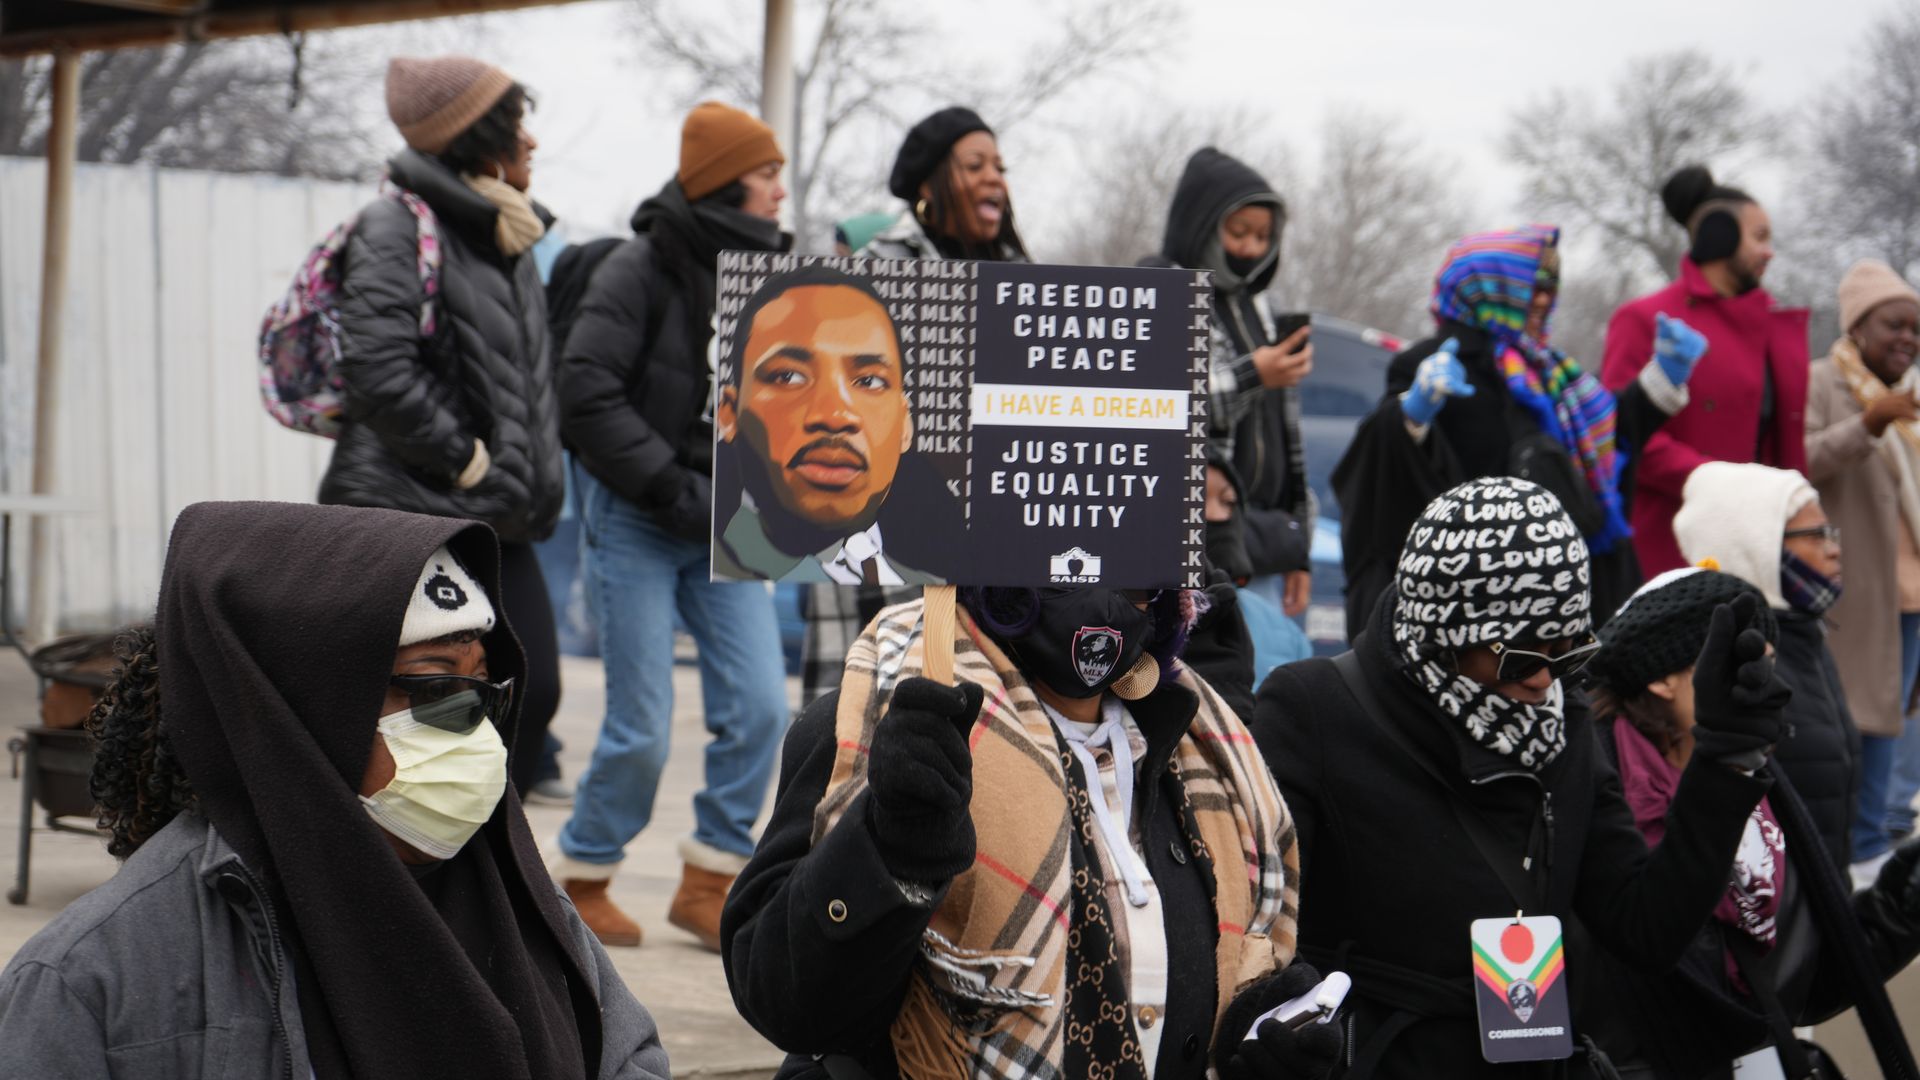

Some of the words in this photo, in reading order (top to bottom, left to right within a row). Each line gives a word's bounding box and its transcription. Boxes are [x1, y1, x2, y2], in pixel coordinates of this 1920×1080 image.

[722, 253, 768, 272] MLK
[872, 260, 917, 277] MLK
[921, 261, 967, 279] MLK
[921, 281, 967, 300] MLK
[996, 282, 1157, 309] FREEDOM
[889, 303, 916, 321] LK
[920, 304, 966, 322] MLK
[920, 326, 965, 344] MLK
[1013, 314, 1152, 340] CHANGE
[920, 348, 964, 366] MLK
[1028, 346, 1136, 371] PEACE
[919, 370, 963, 388] MLK
[918, 391, 963, 410] MLK
[986, 393, 992, 414] I
[1001, 393, 1062, 415] HAVE
[1069, 396, 1085, 416] A
[1093, 396, 1175, 418] DREAM
[918, 413, 962, 431] MLK
[917, 435, 961, 453] MLK
[1002, 440, 1149, 466] JUSTICE
[991, 471, 1159, 499] EQUALITY
[1023, 503, 1126, 528] UNITY
[1464, 501, 1526, 522] LOVE
[1431, 525, 1518, 551] JUICY
[1478, 545, 1564, 572] LOVE
[1050, 575, 1101, 584] SAISD
[1402, 570, 1574, 599] COUTURE
[1463, 597, 1557, 619] LOVE
[1434, 620, 1530, 647] JUICY
[1488, 1026, 1565, 1040] COMMISSIONER
